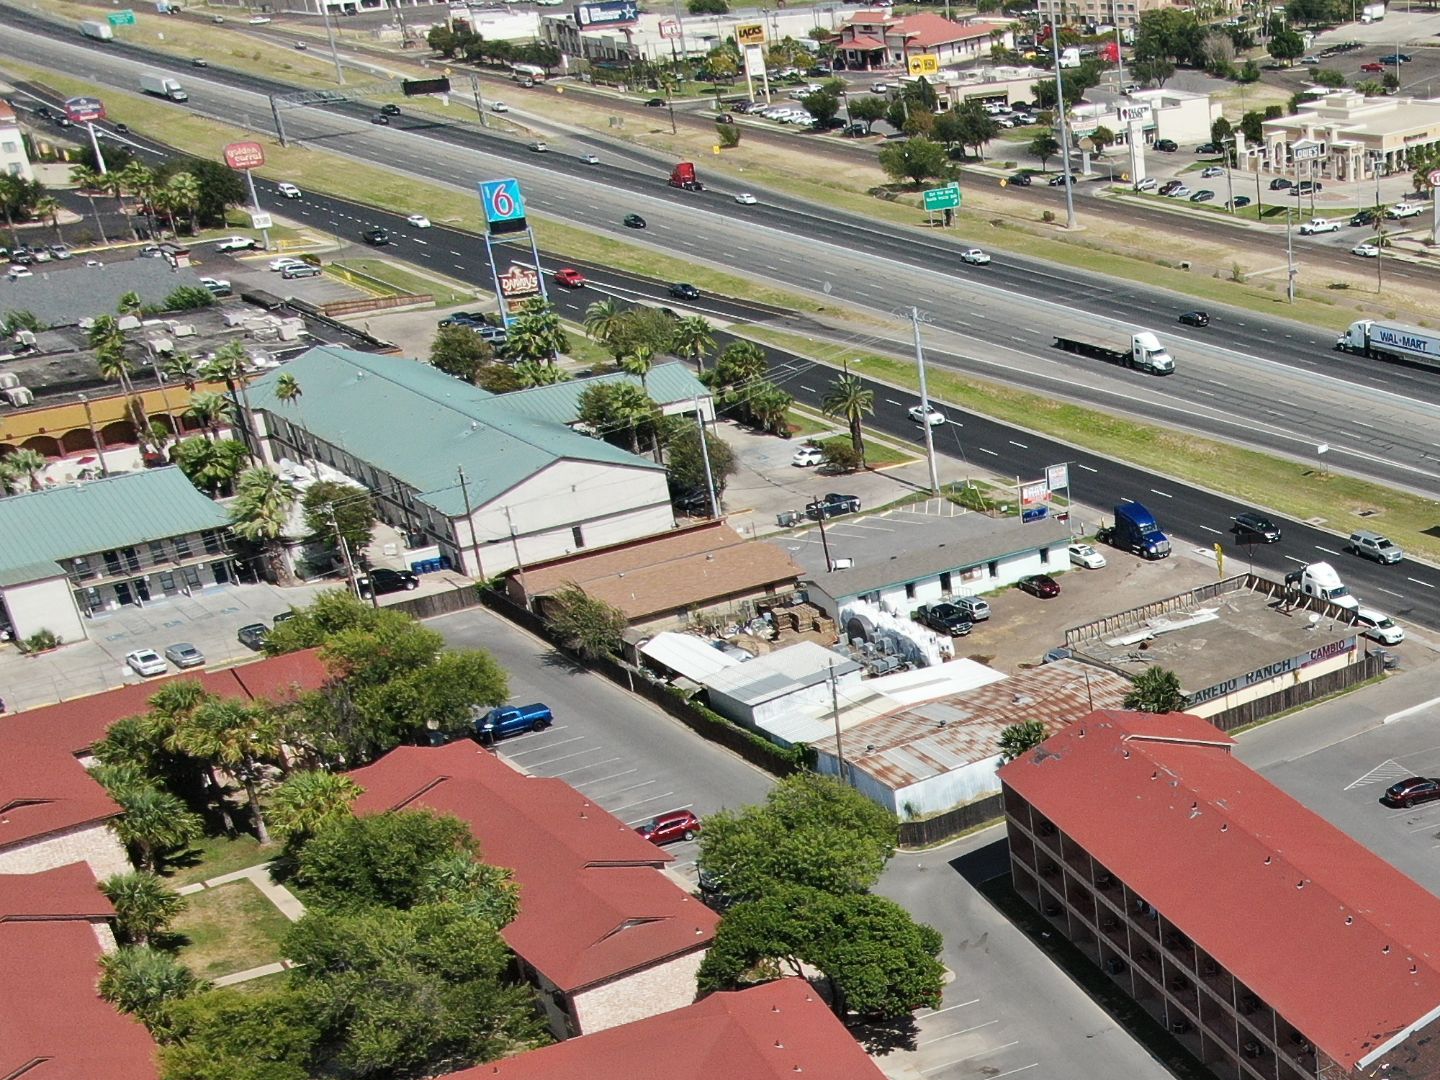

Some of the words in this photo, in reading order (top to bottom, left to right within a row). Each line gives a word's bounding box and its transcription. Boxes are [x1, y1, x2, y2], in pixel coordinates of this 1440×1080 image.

[492, 184, 514, 216] 6
[1310, 639, 1345, 660] CAMBIO
[1245, 658, 1291, 685] RANCH
